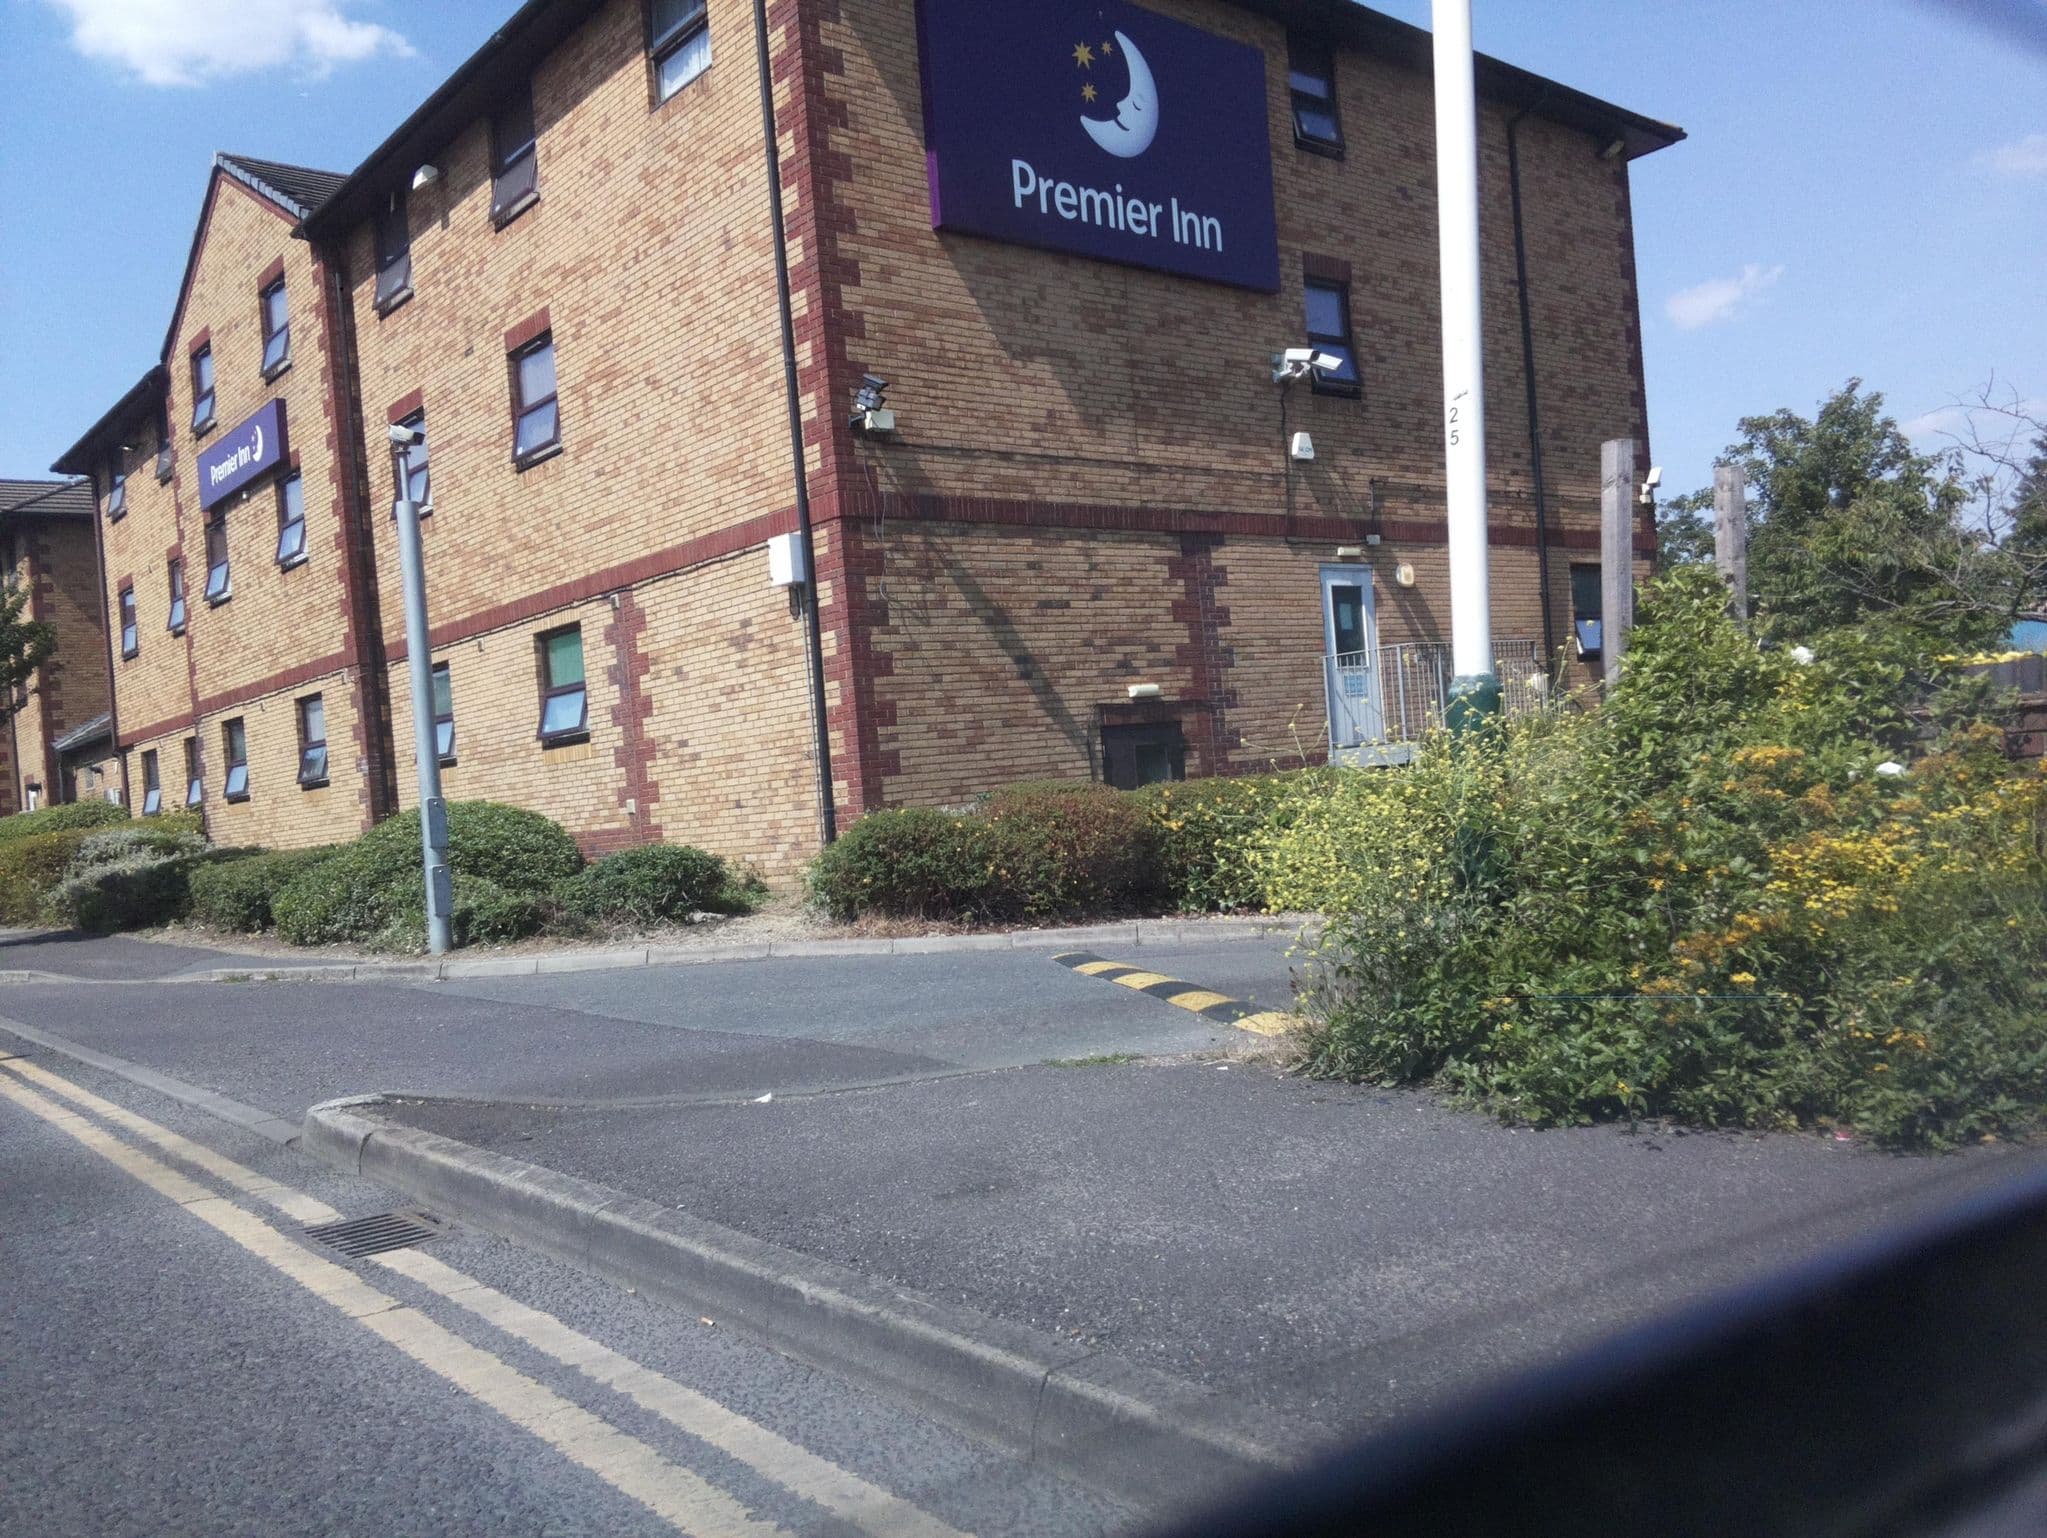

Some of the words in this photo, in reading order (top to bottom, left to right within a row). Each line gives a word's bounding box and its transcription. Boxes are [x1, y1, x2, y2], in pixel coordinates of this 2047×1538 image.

[1011, 159, 1163, 238] Premier
[1171, 197, 1223, 252] Inn
[210, 454, 238, 486] Premier
[238, 445, 250, 468] Inn
